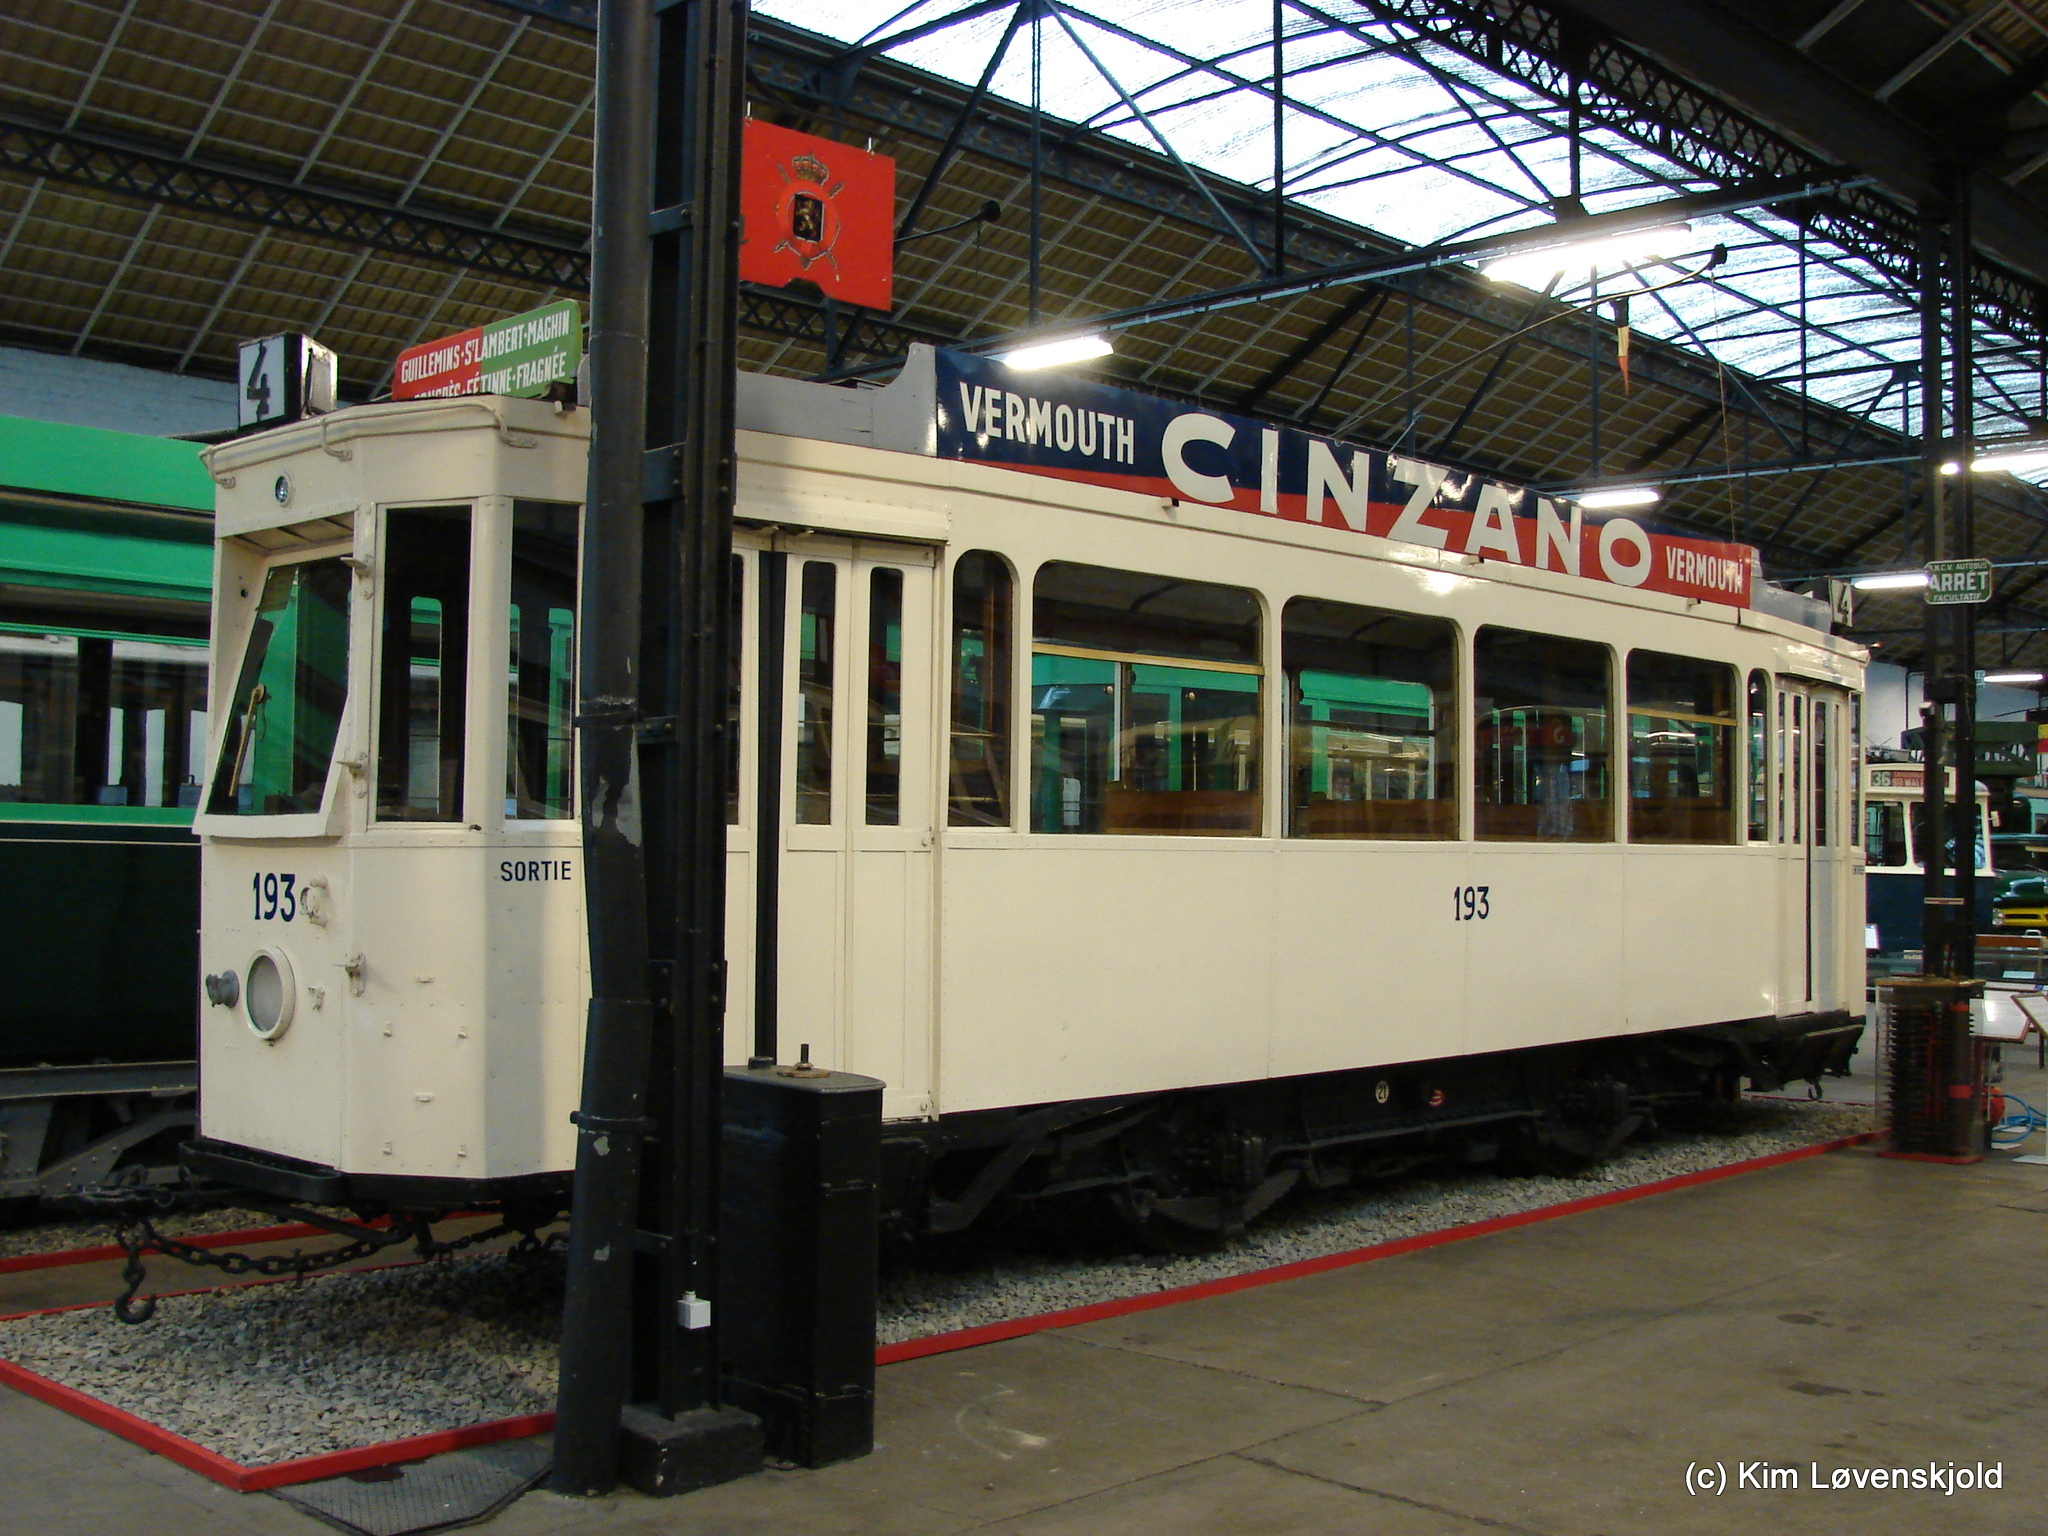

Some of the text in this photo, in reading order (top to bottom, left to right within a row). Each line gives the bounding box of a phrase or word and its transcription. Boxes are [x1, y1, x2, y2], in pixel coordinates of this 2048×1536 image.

[247, 340, 271, 416] 4
[960, 381, 1743, 594] VERMOUTH CINZANO VERMOUTH
[1837, 584, 1849, 624] 4
[1933, 592, 1982, 602] FACULTATIF
[1872, 771, 1891, 786] 36
[500, 860, 572, 882] SORTIE
[252, 872, 296, 922] 193
[1453, 885, 1490, 921] 193
[1378, 1084, 1387, 1100] 21
